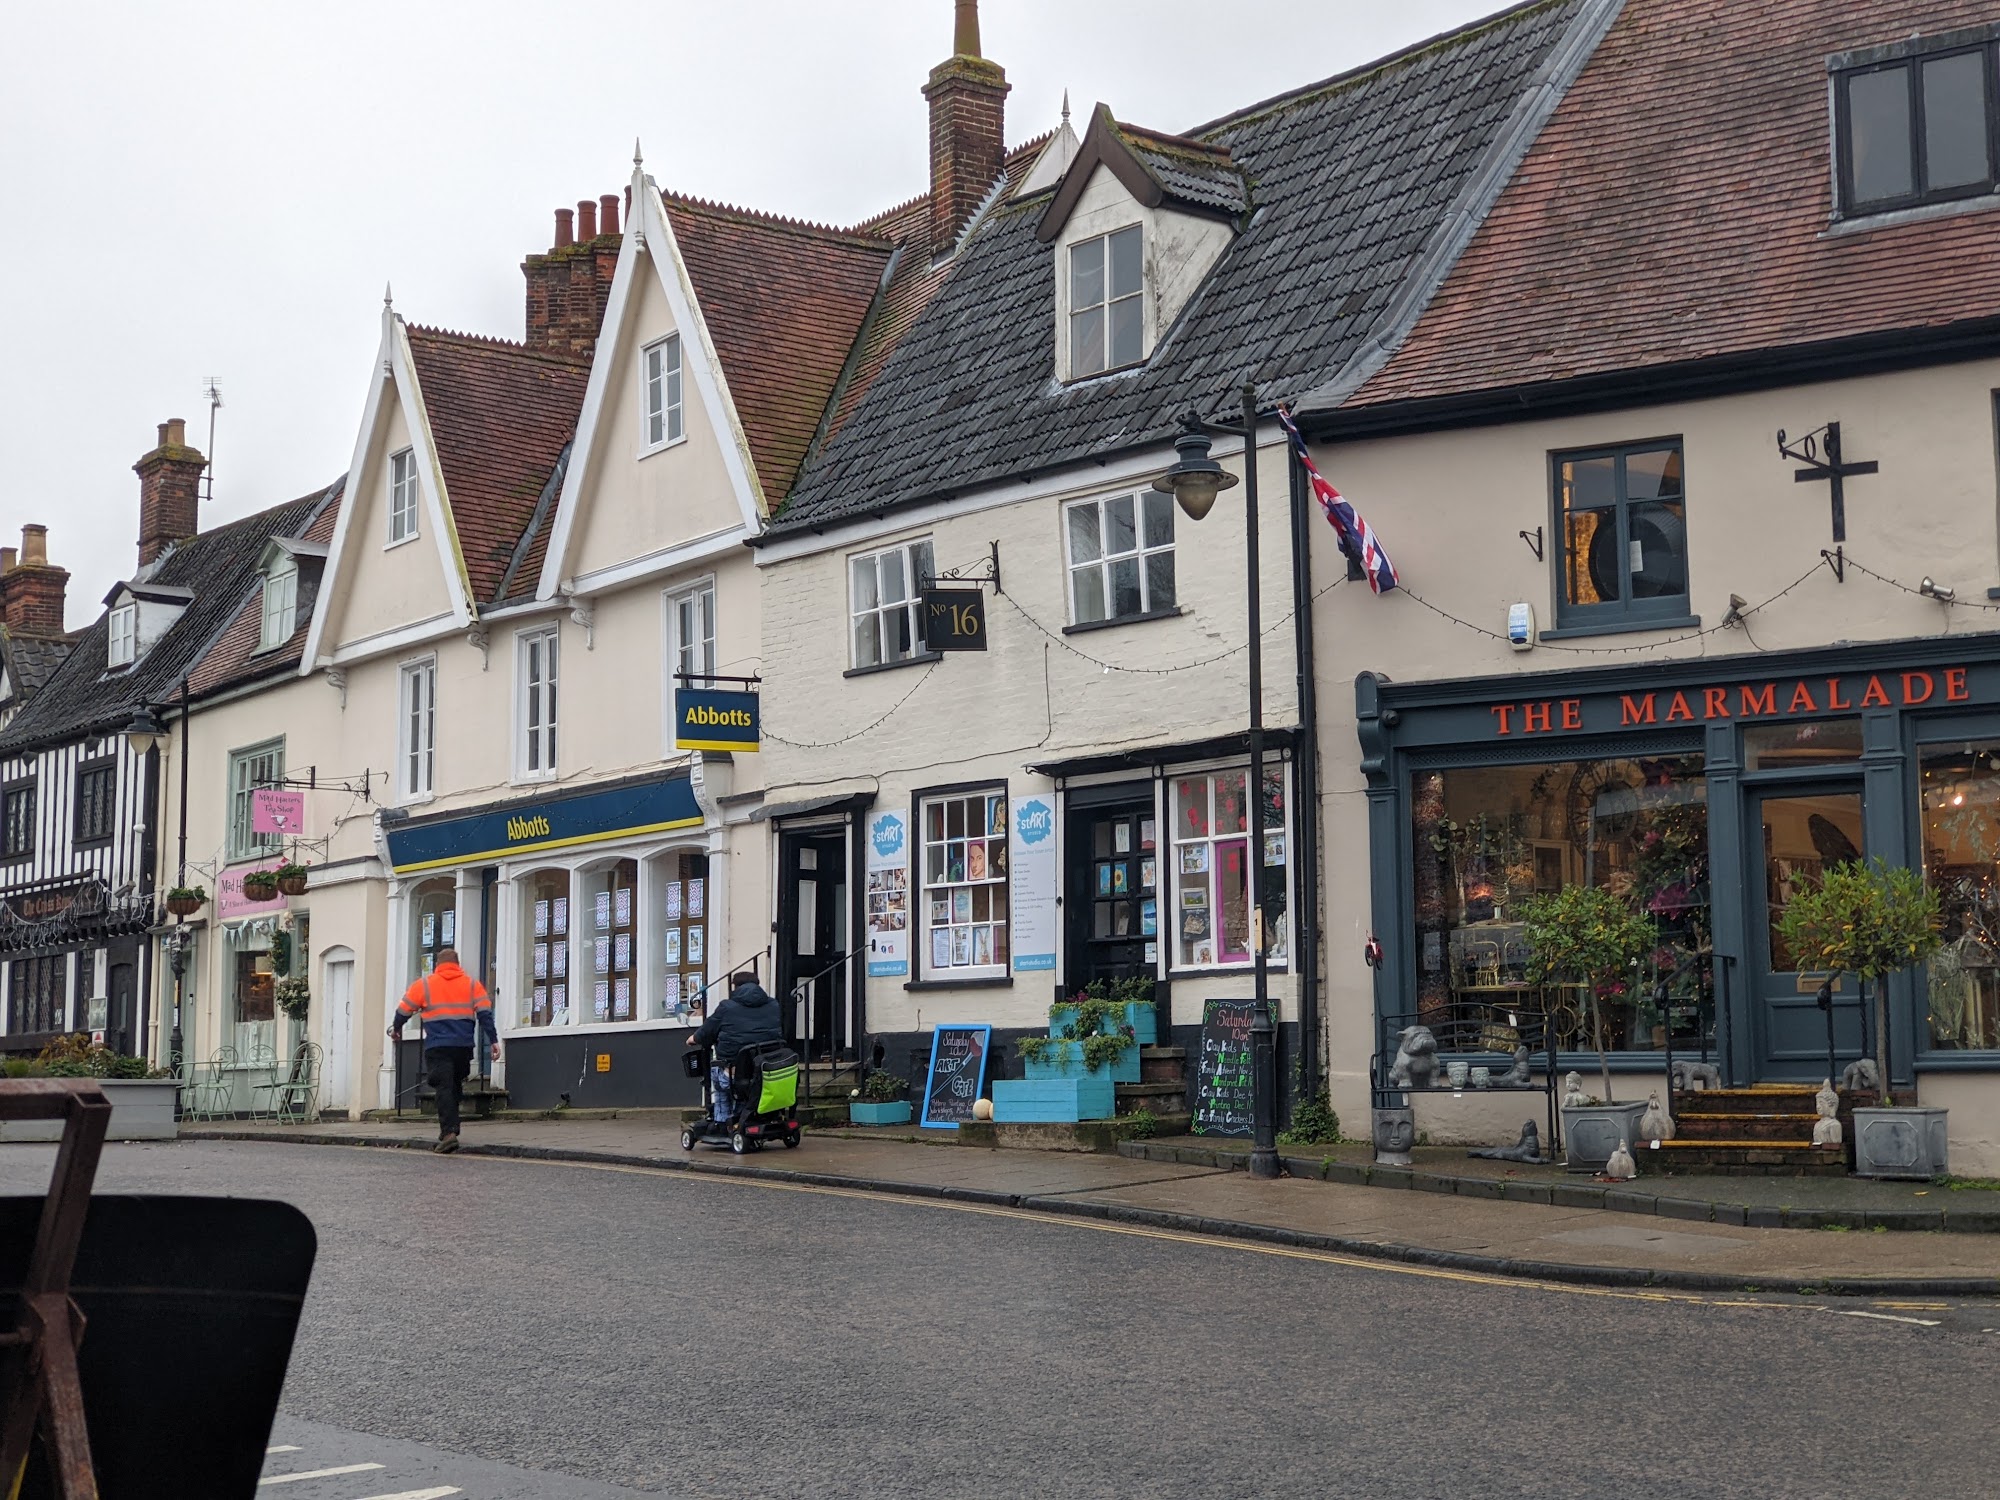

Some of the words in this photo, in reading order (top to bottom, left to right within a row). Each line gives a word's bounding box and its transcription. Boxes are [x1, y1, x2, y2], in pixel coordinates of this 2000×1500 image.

[949, 603, 978, 636] 16
[1491, 699, 1583, 735] THE
[1619, 667, 1970, 726] MARMALADE
[685, 705, 752, 727] Abbotts
[507, 815, 550, 841] Abbotts
[221, 878, 235, 894] Mad
[1217, 1010, 1254, 1027] Saturda
[1221, 1040, 1237, 1053] Kids
[935, 1058, 960, 1073] ART
[1216, 1086, 1230, 1098] Kids
[1233, 1088, 1246, 1100] Dec
[1234, 1099, 1245, 1110] Dec
